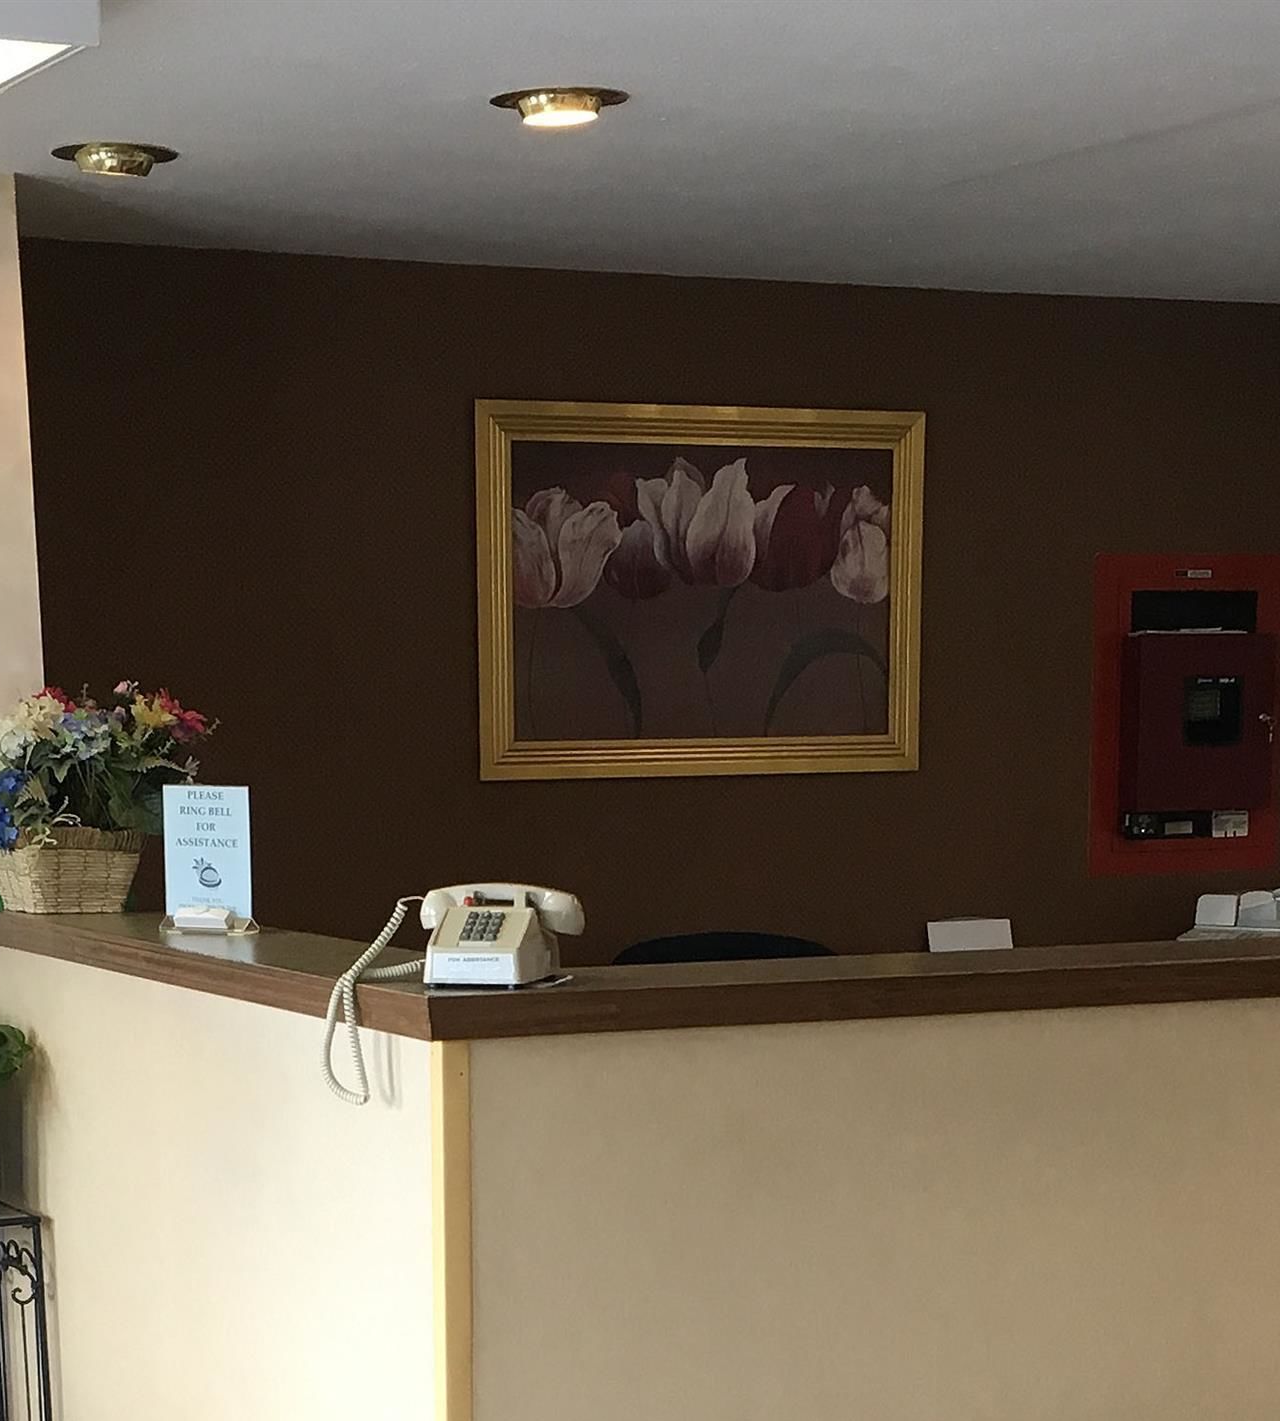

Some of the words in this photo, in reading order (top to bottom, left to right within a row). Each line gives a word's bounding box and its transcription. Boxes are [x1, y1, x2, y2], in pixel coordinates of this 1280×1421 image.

[187, 790, 225, 801] PLEASE
[179, 806, 207, 816] RING
[208, 807, 232, 817] BELL
[196, 822, 217, 832] FOR
[176, 838, 240, 849] ASSISTANCE
